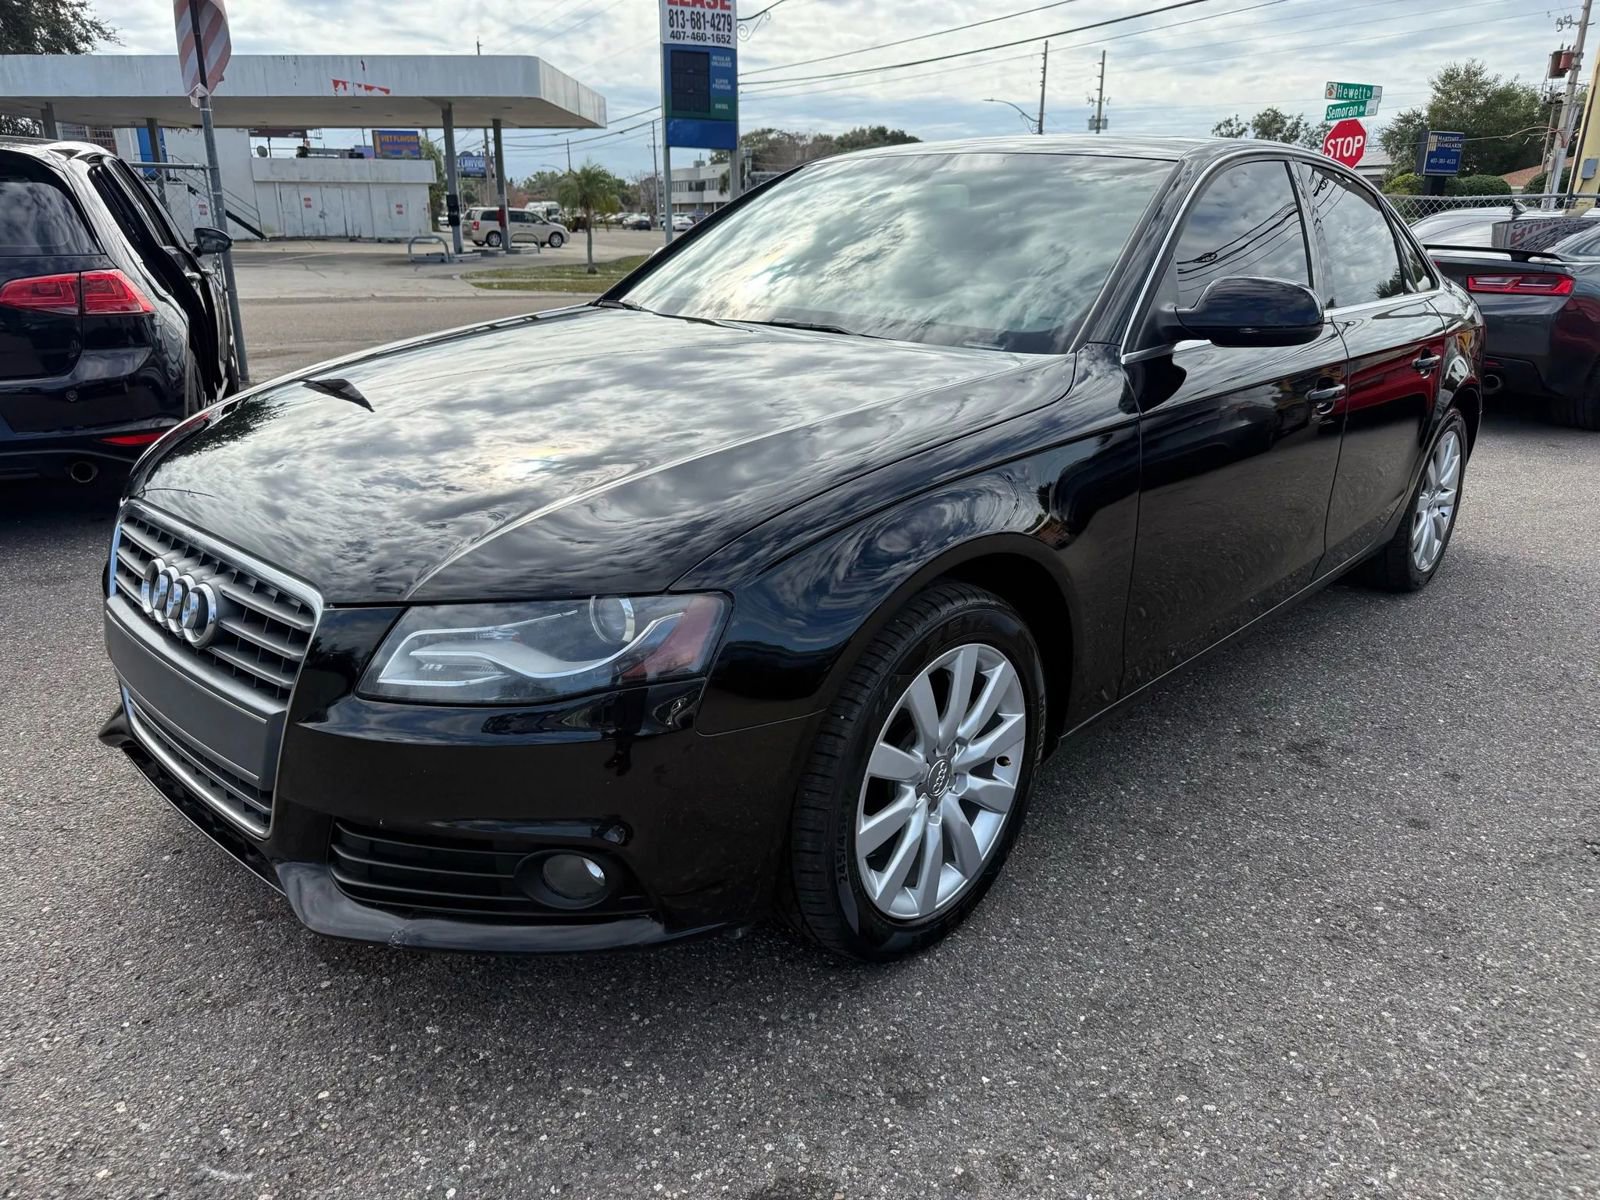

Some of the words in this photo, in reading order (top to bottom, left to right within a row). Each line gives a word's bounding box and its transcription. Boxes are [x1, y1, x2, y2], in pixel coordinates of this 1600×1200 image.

[668, 9, 732, 32] 813-681-4279
[670, 31, 731, 44] 407-460-1652
[1337, 85, 1366, 99] Hewett
[1327, 105, 1358, 119] Semoran
[1325, 136, 1364, 158] STOP
